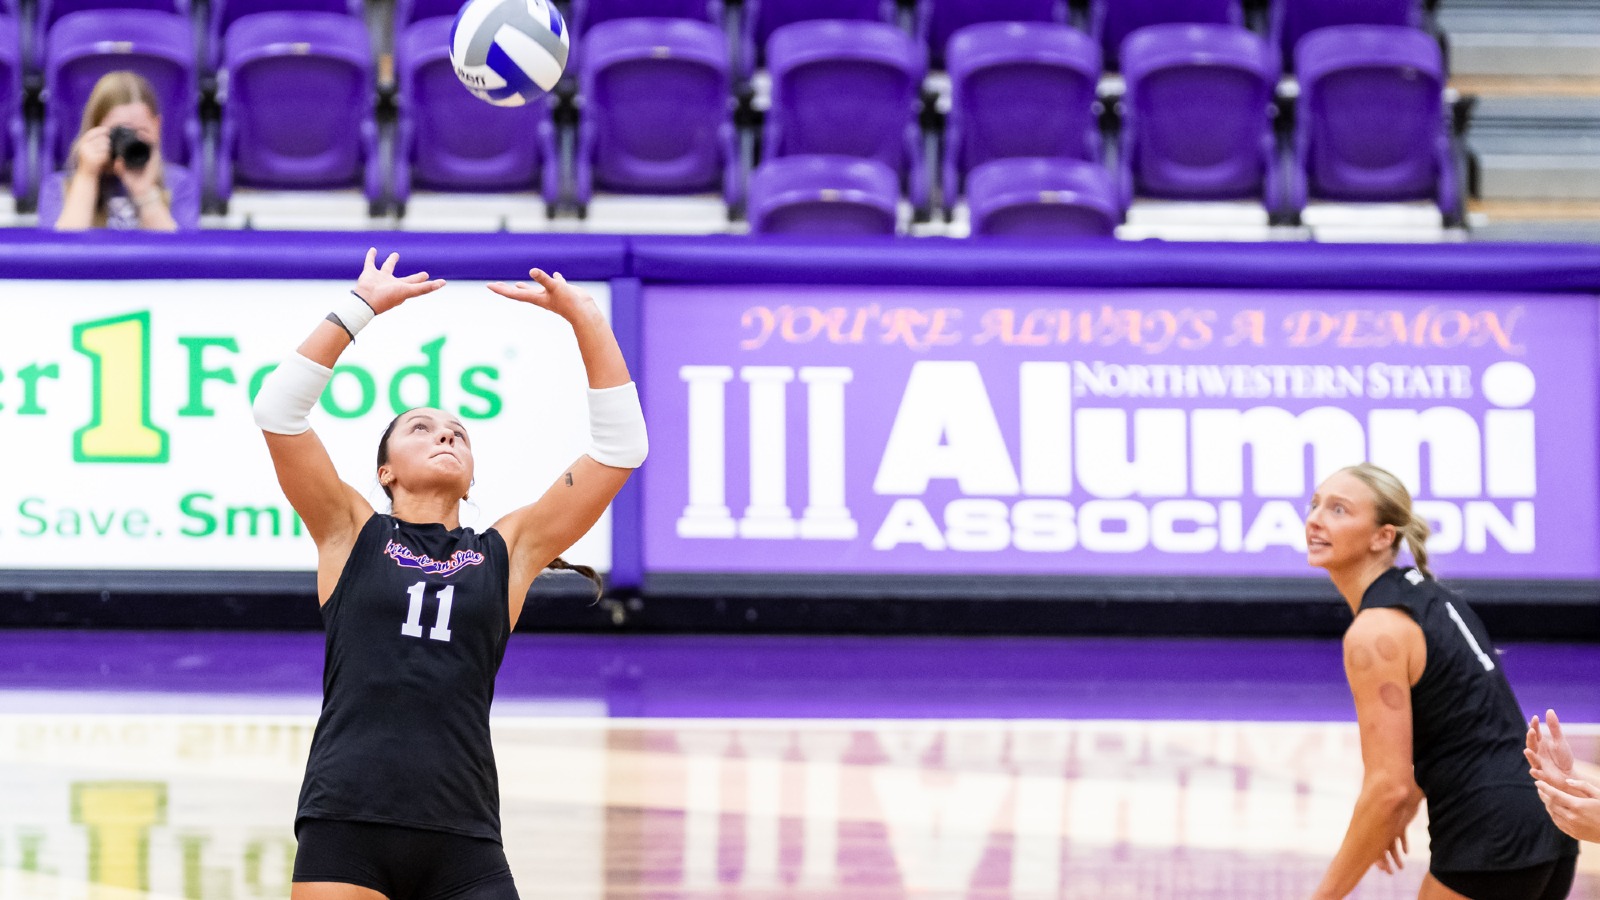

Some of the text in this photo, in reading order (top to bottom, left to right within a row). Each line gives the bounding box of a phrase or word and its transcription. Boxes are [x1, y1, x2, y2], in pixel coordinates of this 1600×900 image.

[740, 303, 1526, 355] YOU'RE ALWAYS A DEMON
[0, 361, 60, 415] r
[872, 360, 1537, 500] Alumni
[17, 497, 163, 537] Save.
[872, 498, 1536, 554] ASSOCIAON
[401, 581, 455, 642] 11
